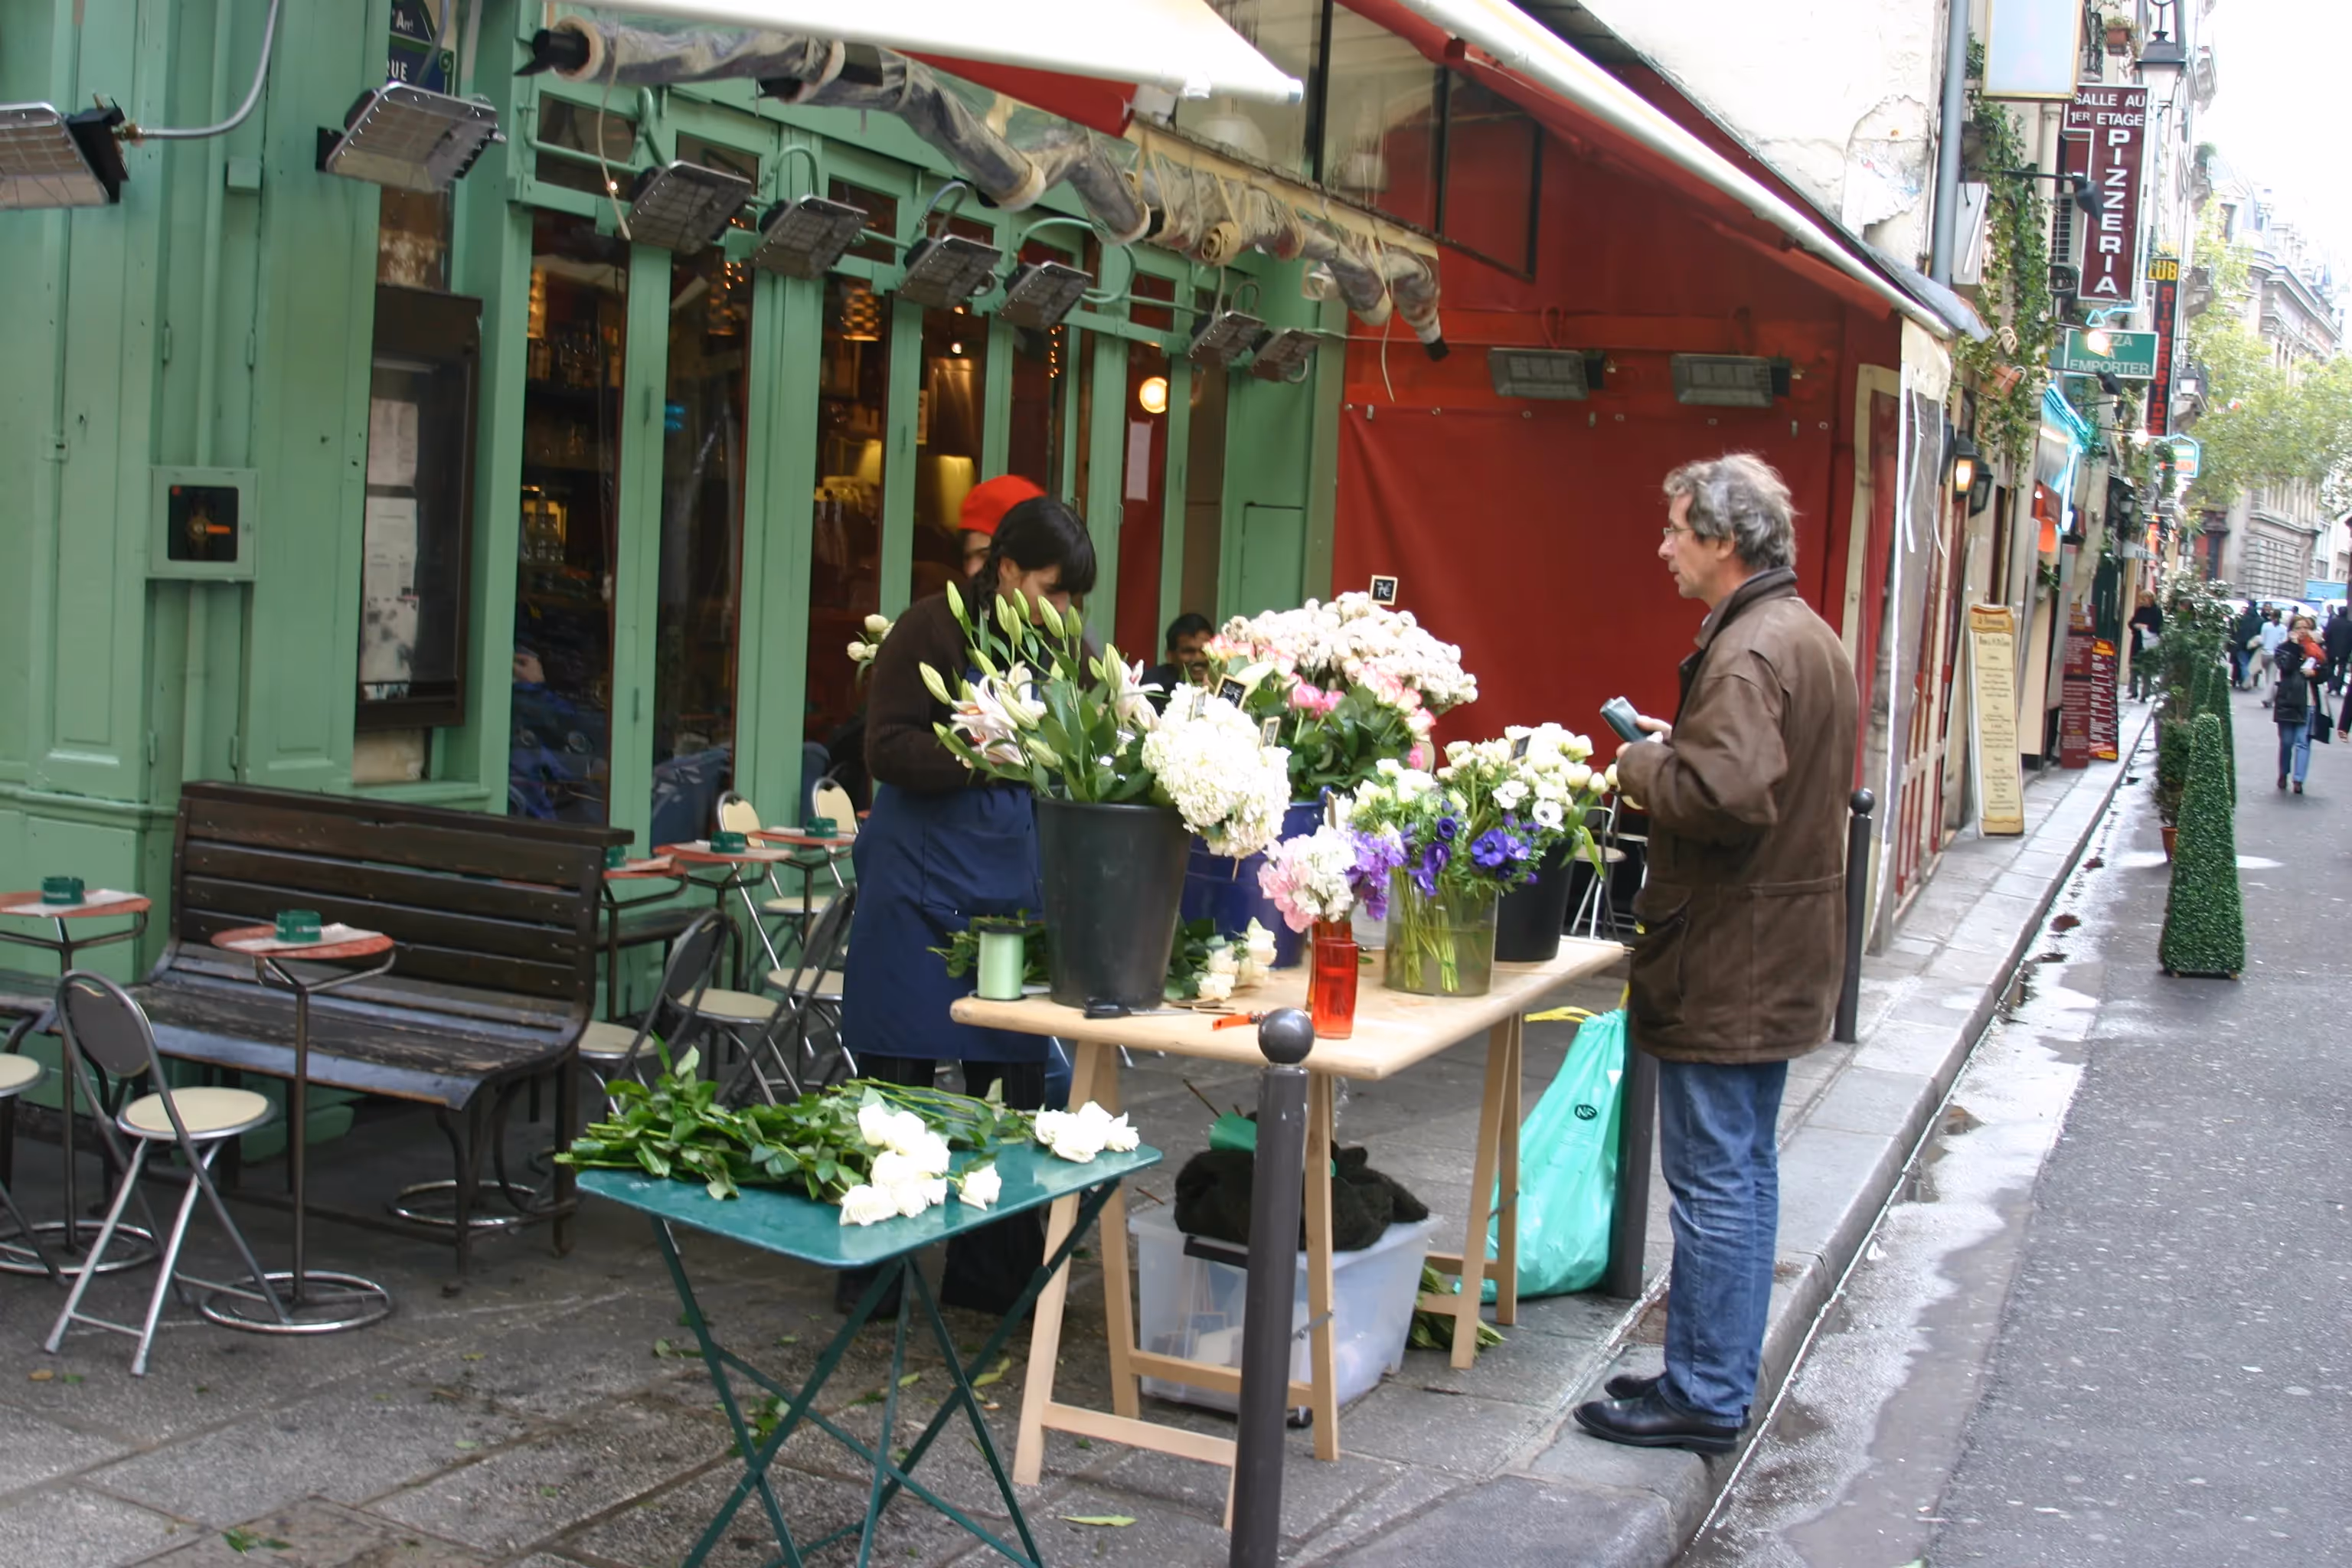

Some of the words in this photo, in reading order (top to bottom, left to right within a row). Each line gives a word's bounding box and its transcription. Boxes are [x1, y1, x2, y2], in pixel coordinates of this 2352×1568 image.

[2074, 93, 2117, 106] SALLE
[2125, 94, 2145, 107] AU
[2070, 112, 2090, 123] 1ER
[2096, 113, 2144, 126] ETAGE
[2093, 129, 2131, 294] PIZZERIA
[2069, 359, 2150, 374] EMPORTER
